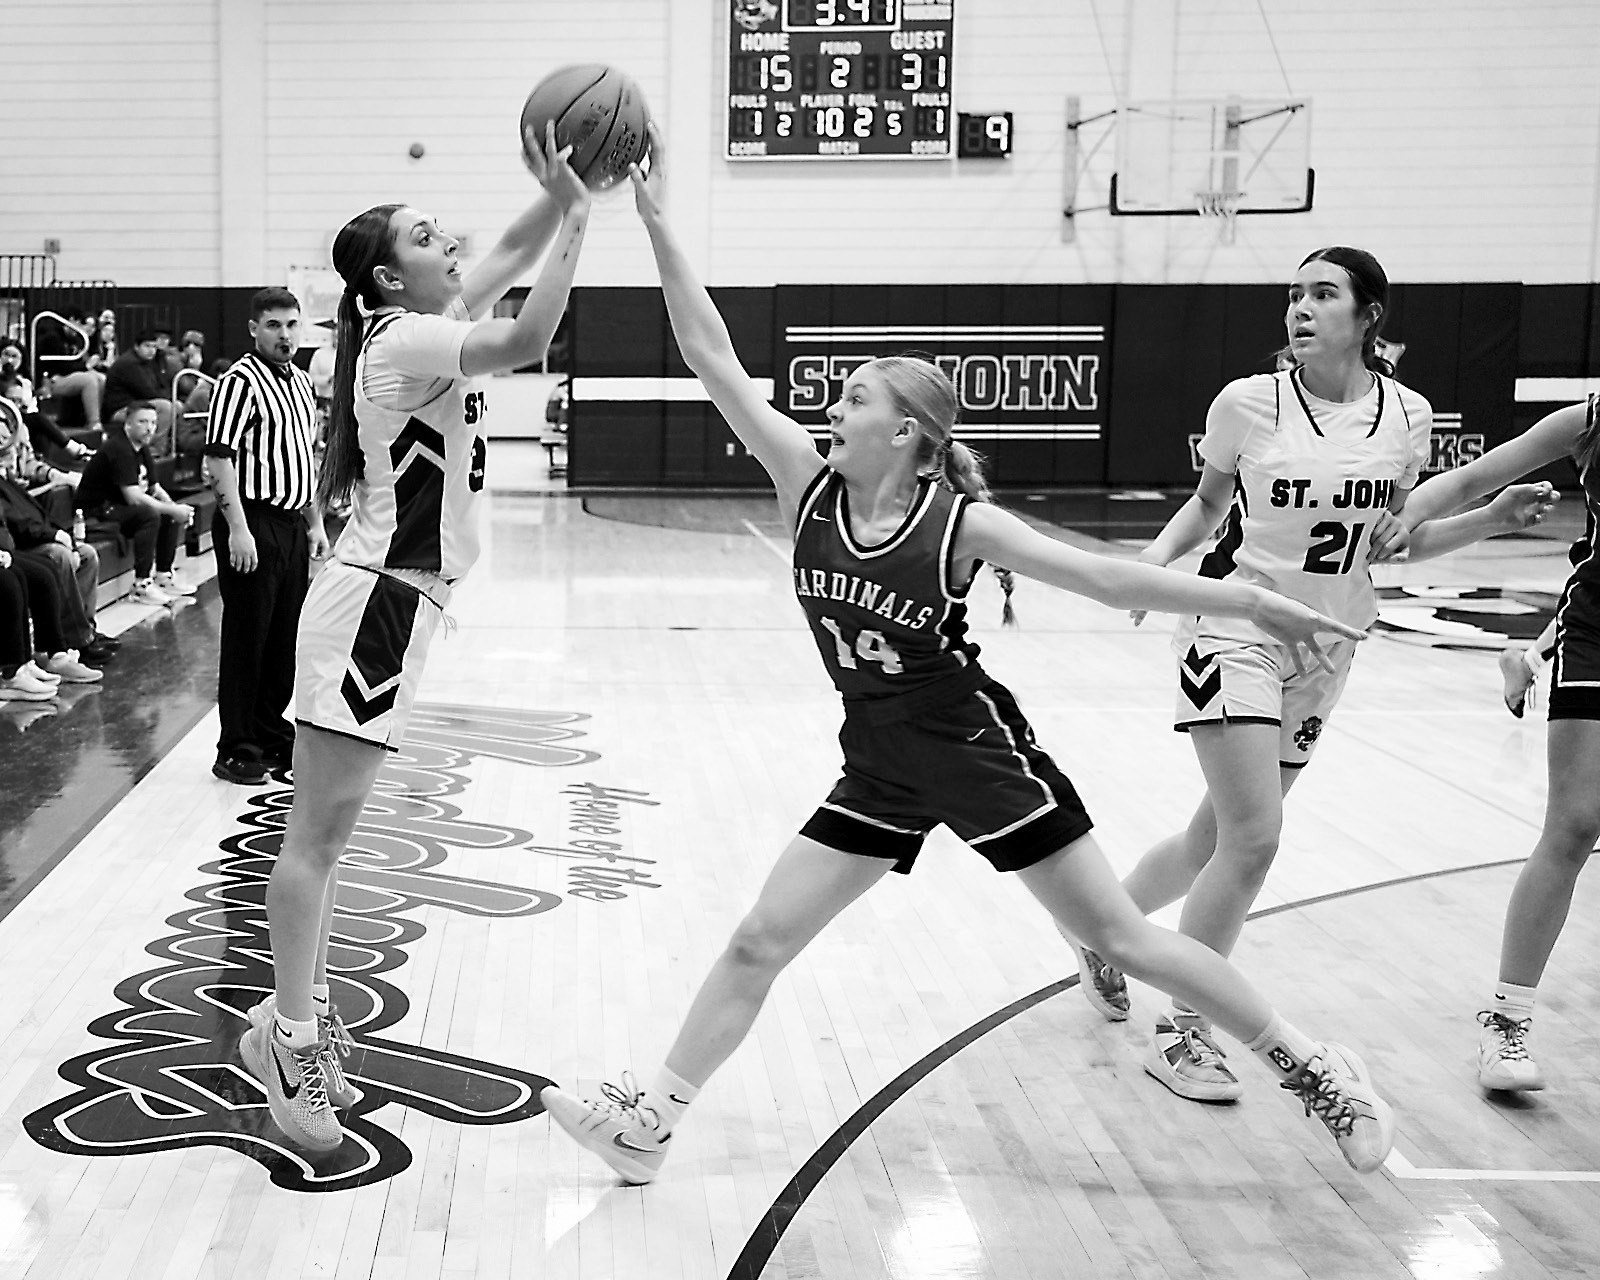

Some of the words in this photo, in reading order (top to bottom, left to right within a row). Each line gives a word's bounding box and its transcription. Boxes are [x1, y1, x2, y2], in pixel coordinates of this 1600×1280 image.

[740, 32, 790, 52] HOME
[890, 31, 946, 50] GUEST
[759, 54, 793, 92] 15
[830, 57, 851, 88] 2
[901, 53, 946, 91] 31
[776, 114, 793, 137] 2
[1269, 478, 1319, 509] ST.
[1302, 520, 1366, 575] 21
[794, 566, 935, 631] ARDINALS
[819, 615, 905, 675] 14
